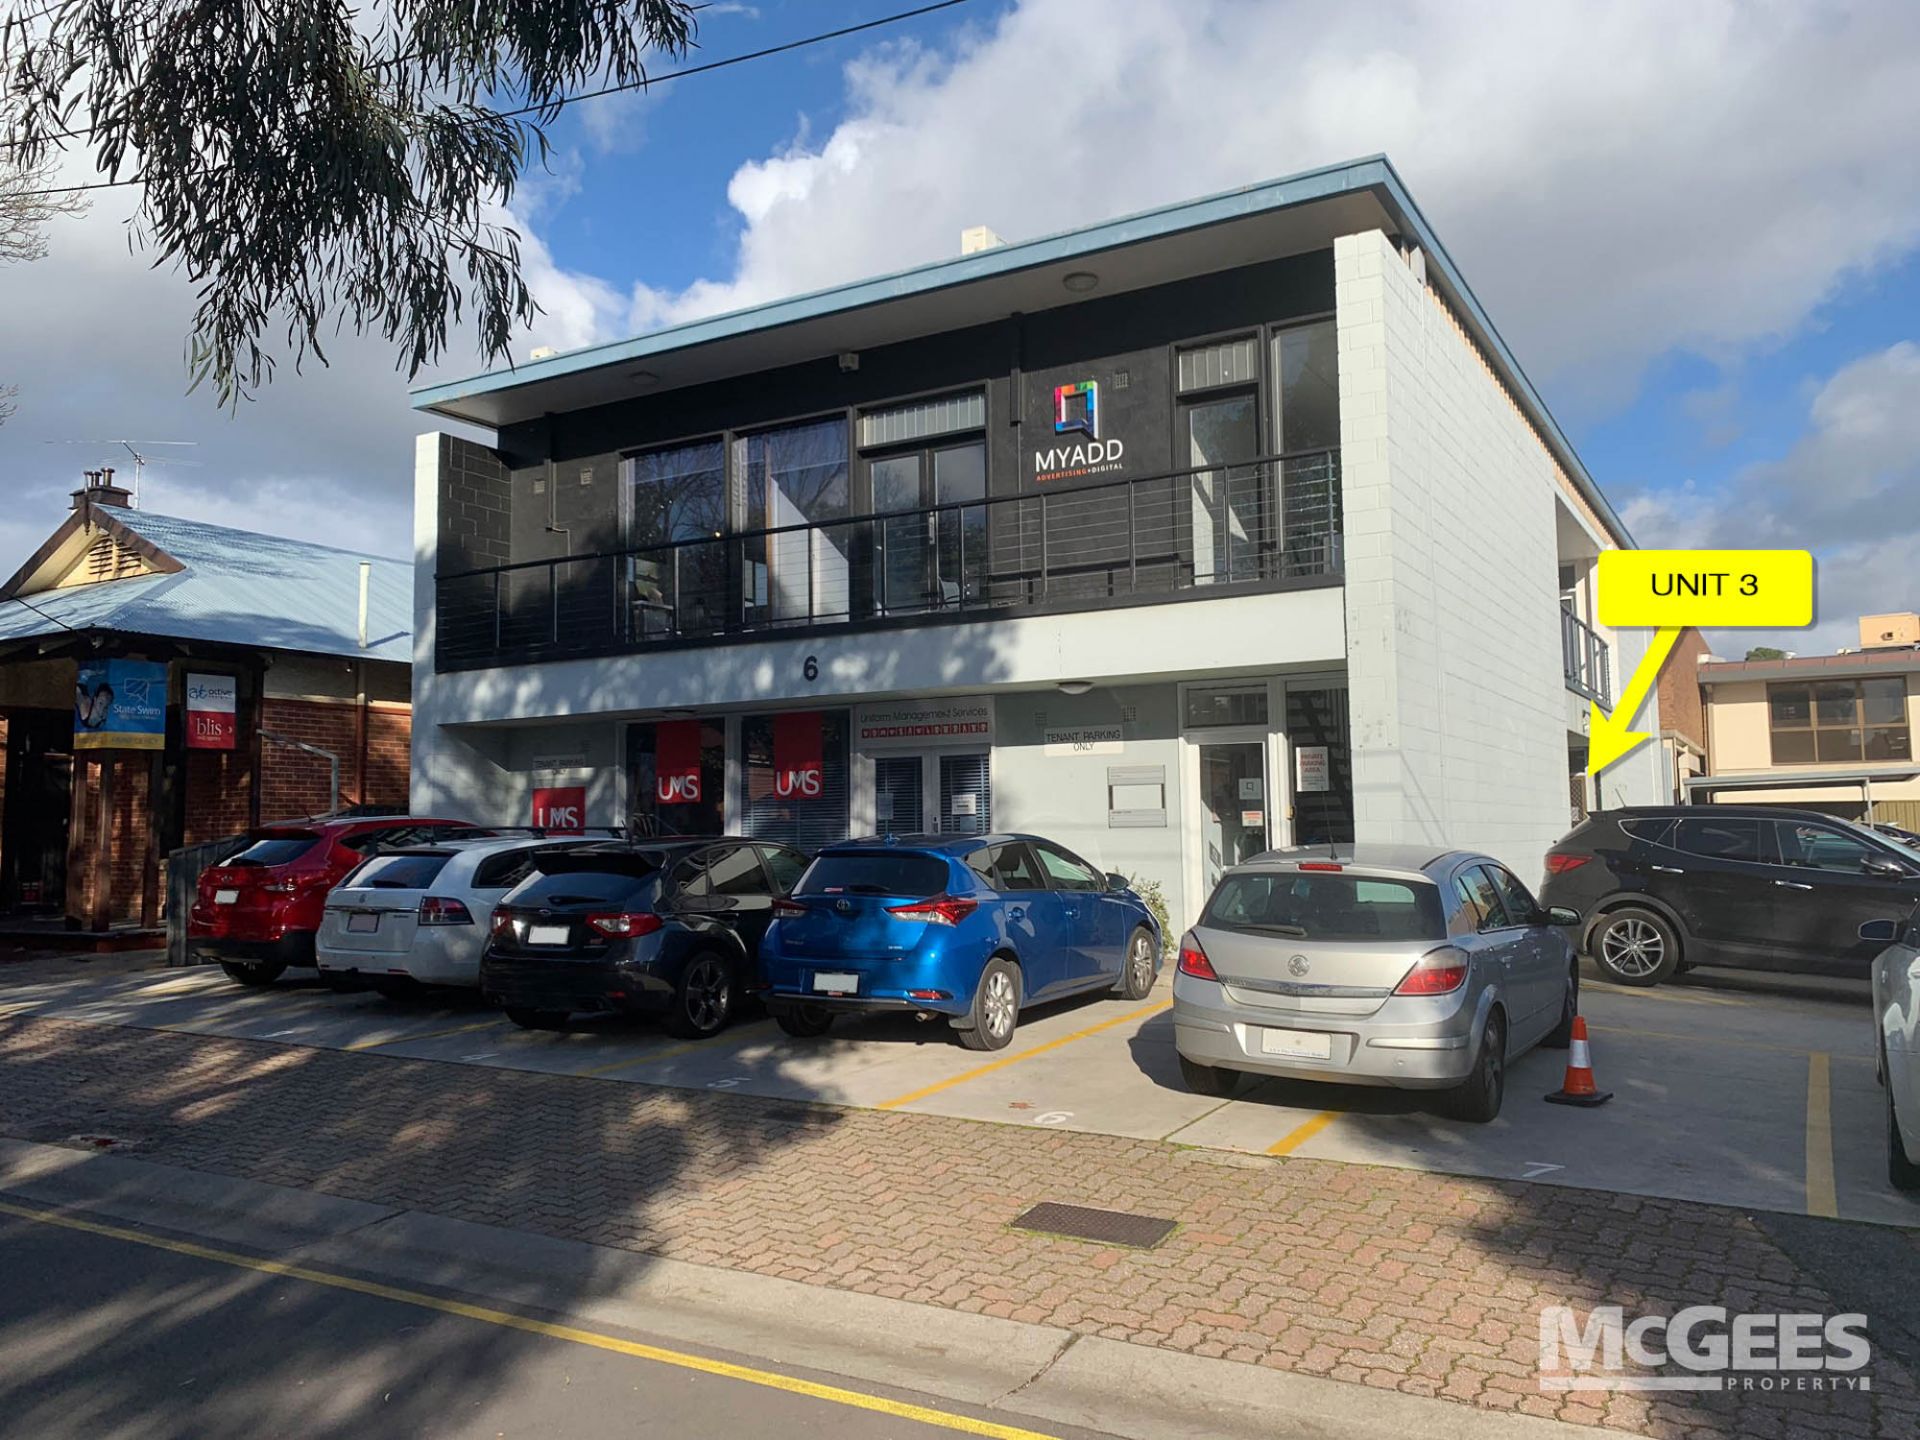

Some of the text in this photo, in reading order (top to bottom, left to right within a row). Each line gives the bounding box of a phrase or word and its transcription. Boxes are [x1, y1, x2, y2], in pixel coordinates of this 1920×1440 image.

[1035, 438, 1123, 473] MYADD
[803, 655, 819, 681] 6
[113, 703, 161, 716] State Swim
[893, 708, 951, 722] Management
[952, 706, 988, 718] Services
[1046, 729, 1121, 743] TENANT PARKING
[1073, 742, 1095, 752] ONLY
[657, 774, 699, 800] UMS
[776, 769, 820, 796] UMS
[538, 805, 579, 829] UMS
